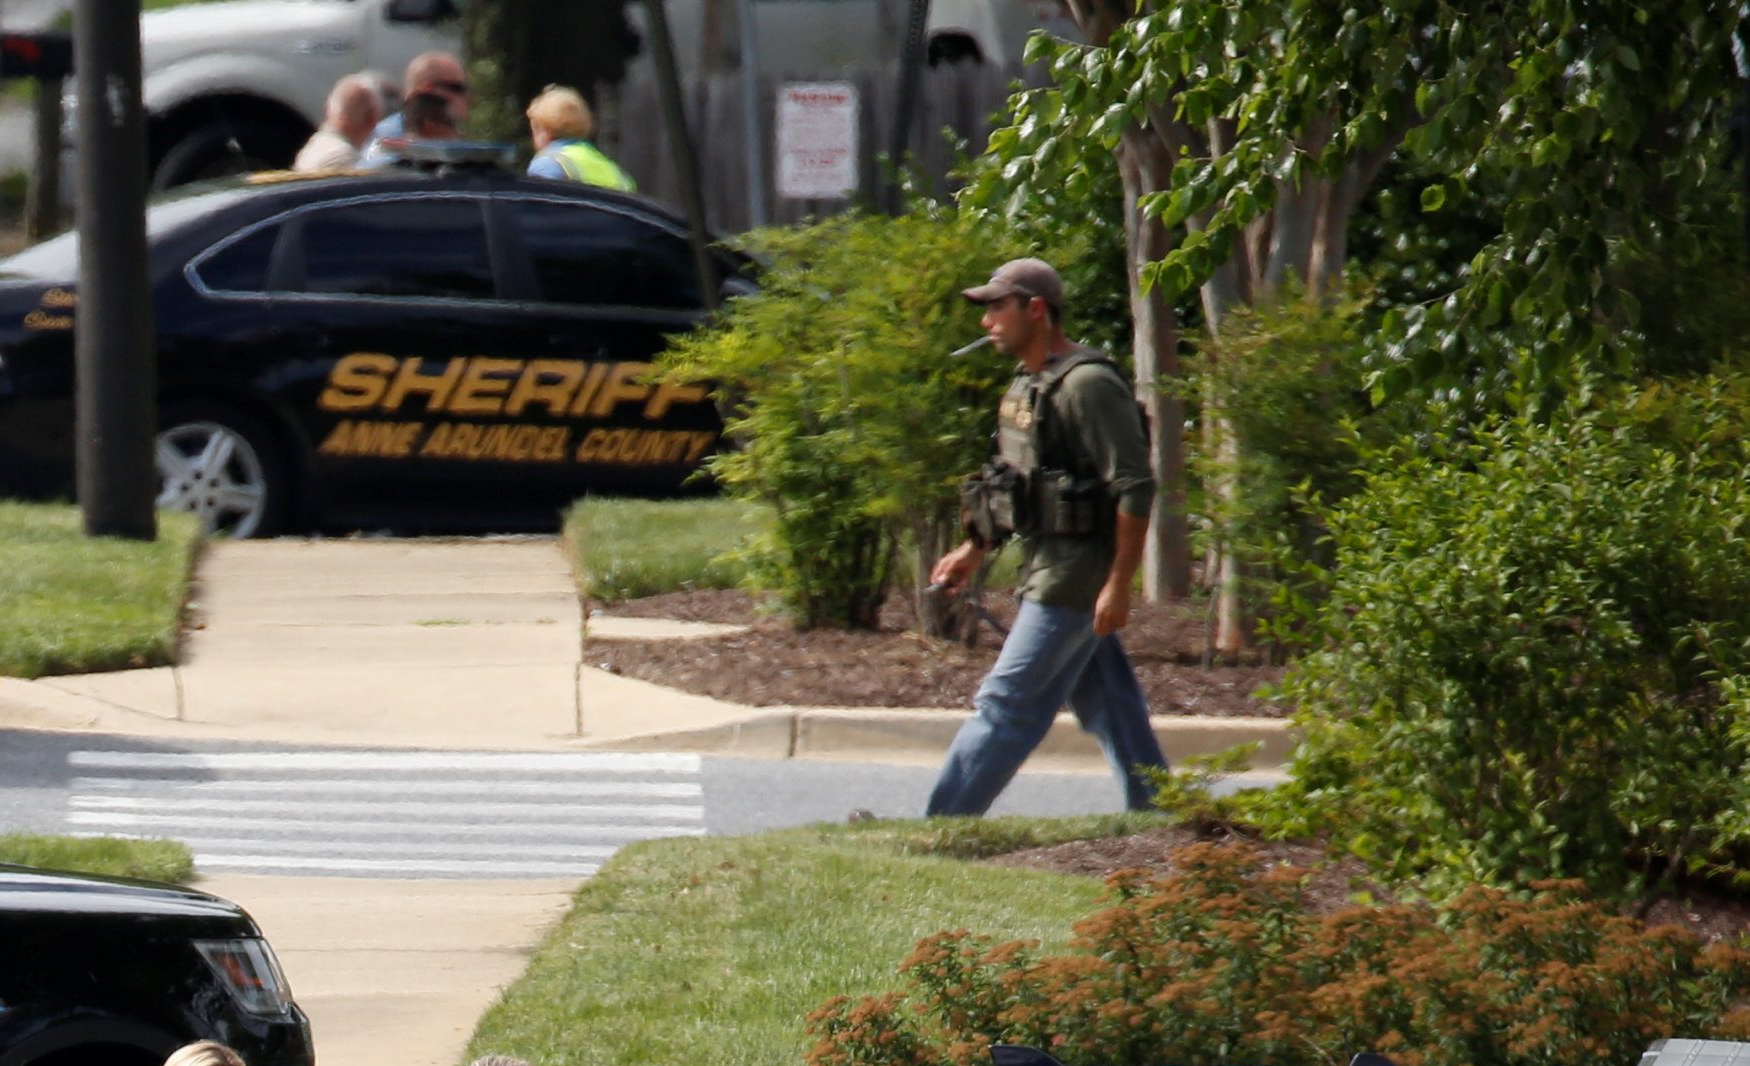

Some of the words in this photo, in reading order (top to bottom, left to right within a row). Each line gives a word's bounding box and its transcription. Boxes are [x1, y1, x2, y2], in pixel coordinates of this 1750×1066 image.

[317, 352, 709, 420] SHERIFF
[317, 419, 427, 458] ANNE
[419, 421, 573, 463] ARUNDEL
[576, 427, 718, 464] COUNTY
